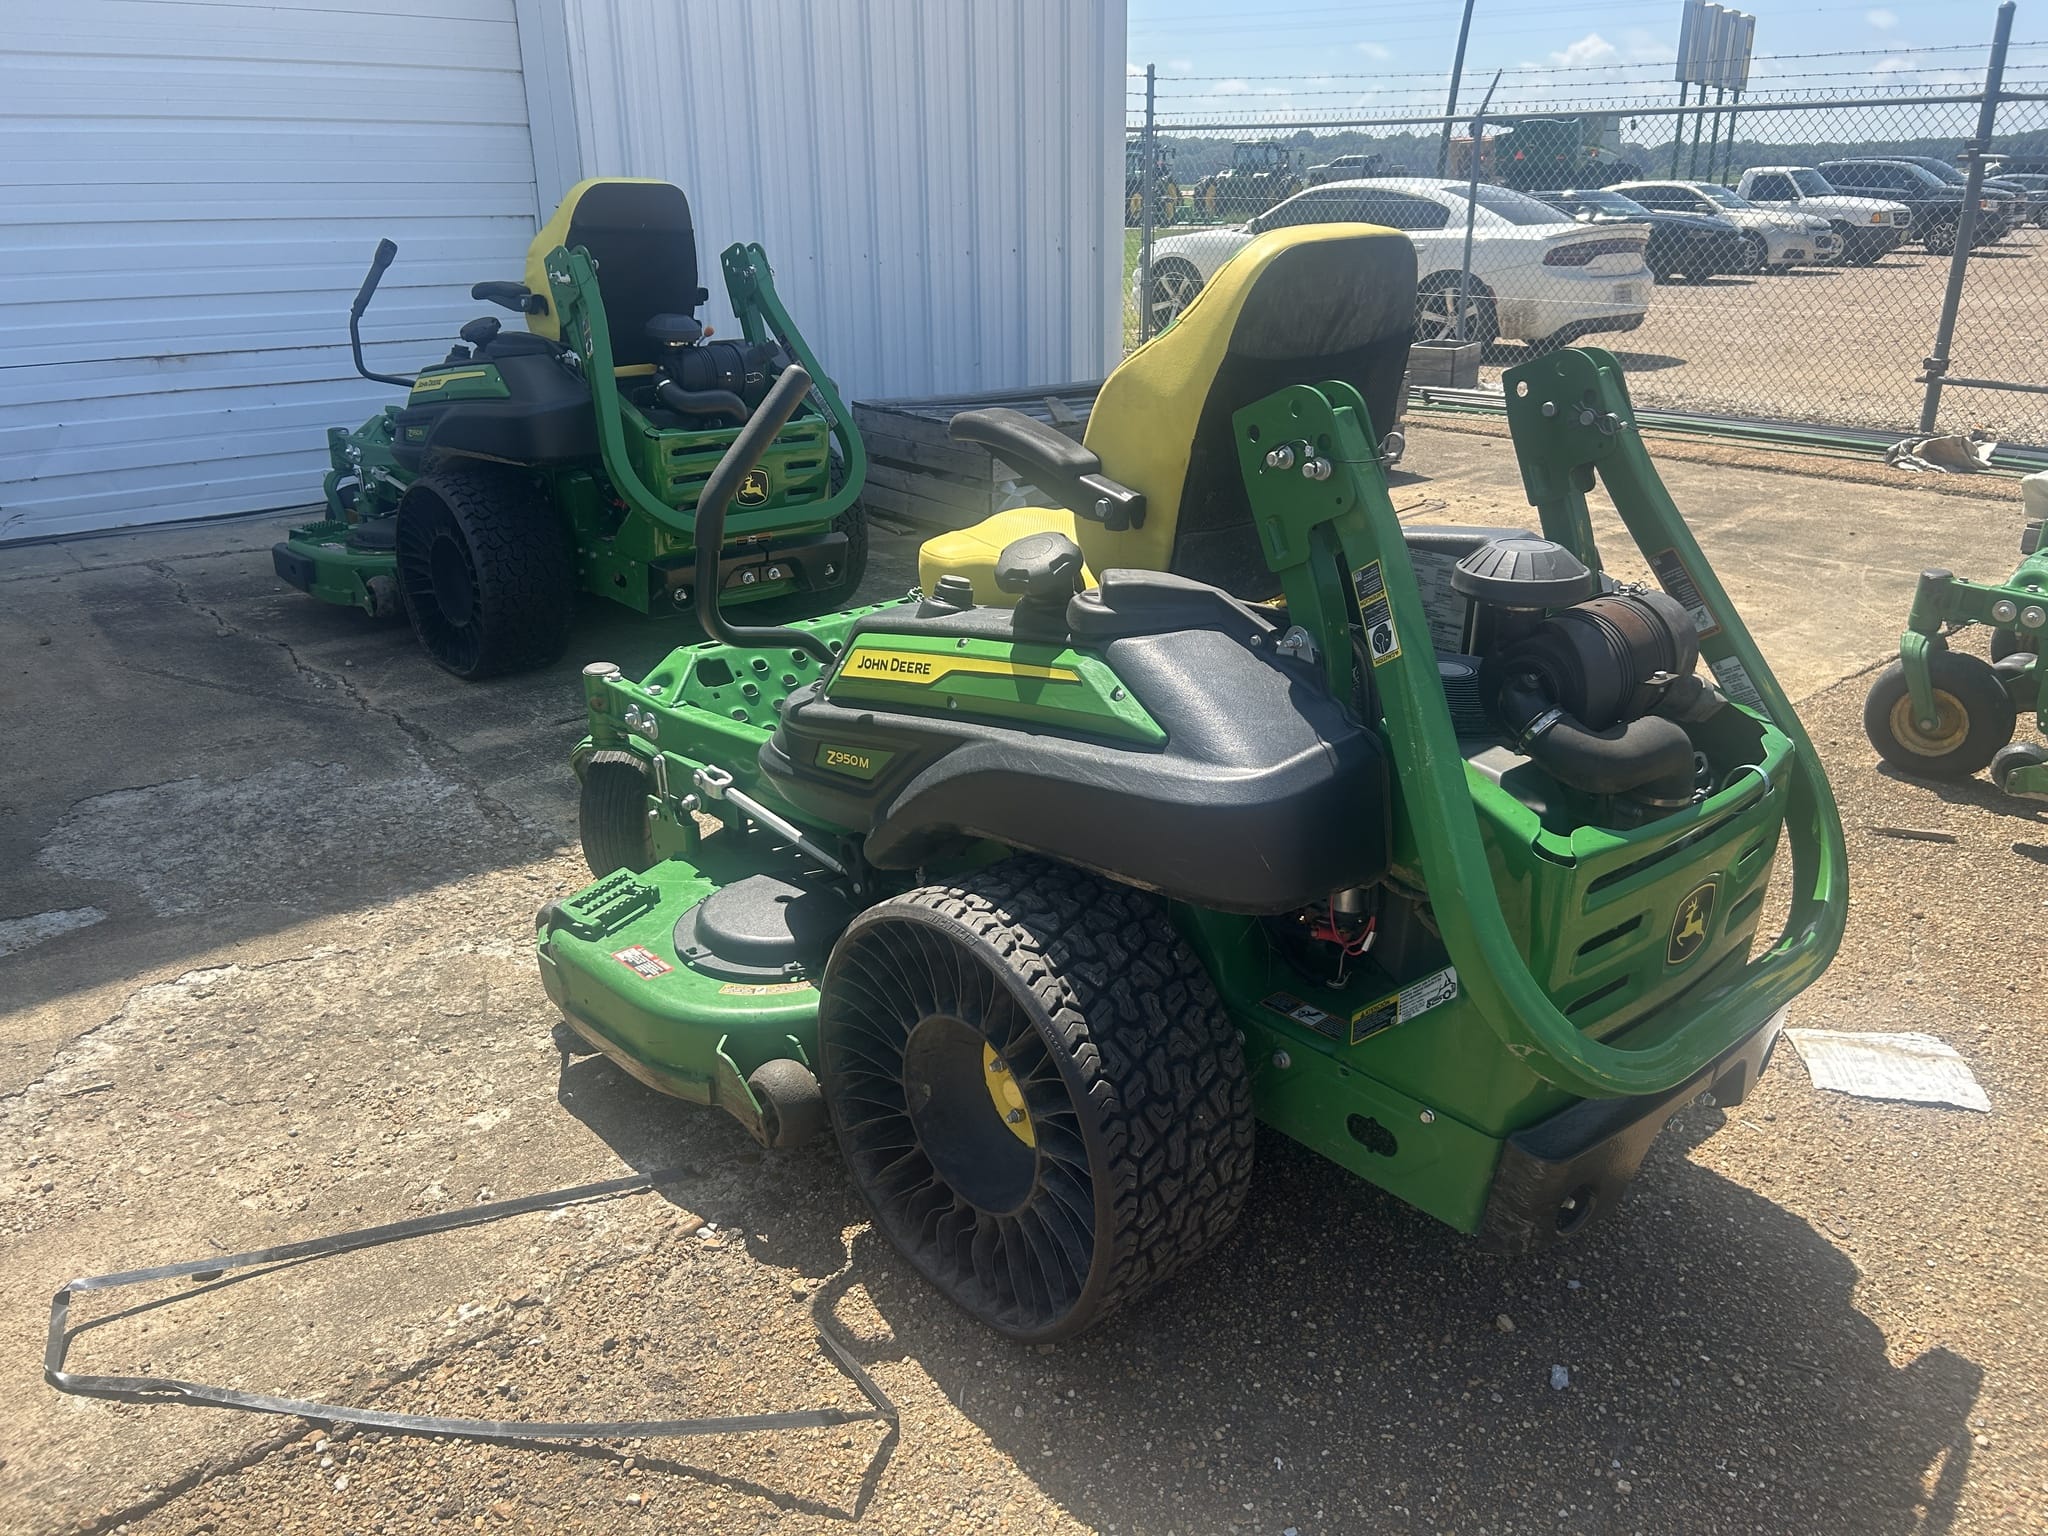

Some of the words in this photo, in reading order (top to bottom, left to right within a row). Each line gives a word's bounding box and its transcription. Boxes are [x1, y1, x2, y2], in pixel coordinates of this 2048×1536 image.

[857, 655, 890, 671] JOHN
[890, 657, 932, 674] DEERE
[826, 750, 870, 769] Z950M
